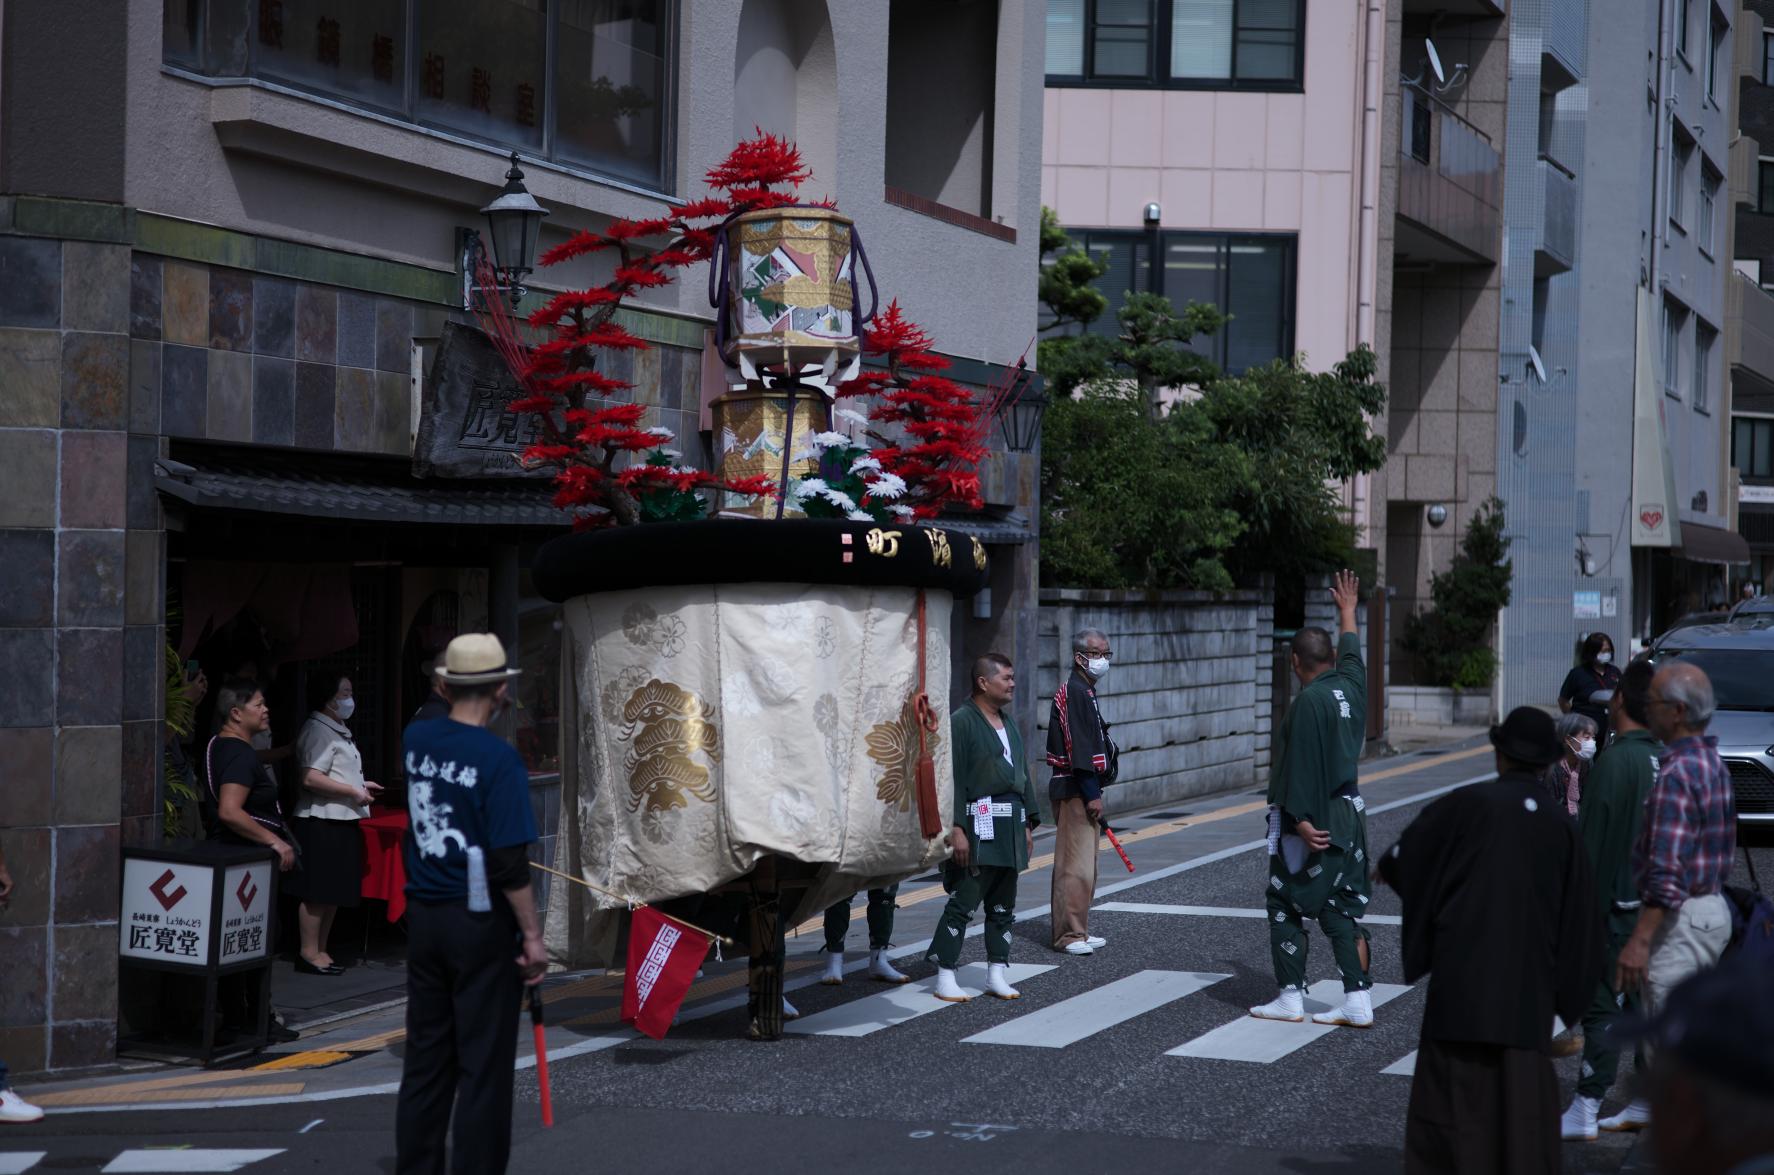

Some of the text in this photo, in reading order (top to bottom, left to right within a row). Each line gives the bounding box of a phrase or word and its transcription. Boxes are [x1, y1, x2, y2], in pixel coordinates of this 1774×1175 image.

[166, 916, 202, 928] しょうかんどう
[129, 925, 200, 957] 匠寛堂
[223, 926, 262, 957] 匠寛堂
